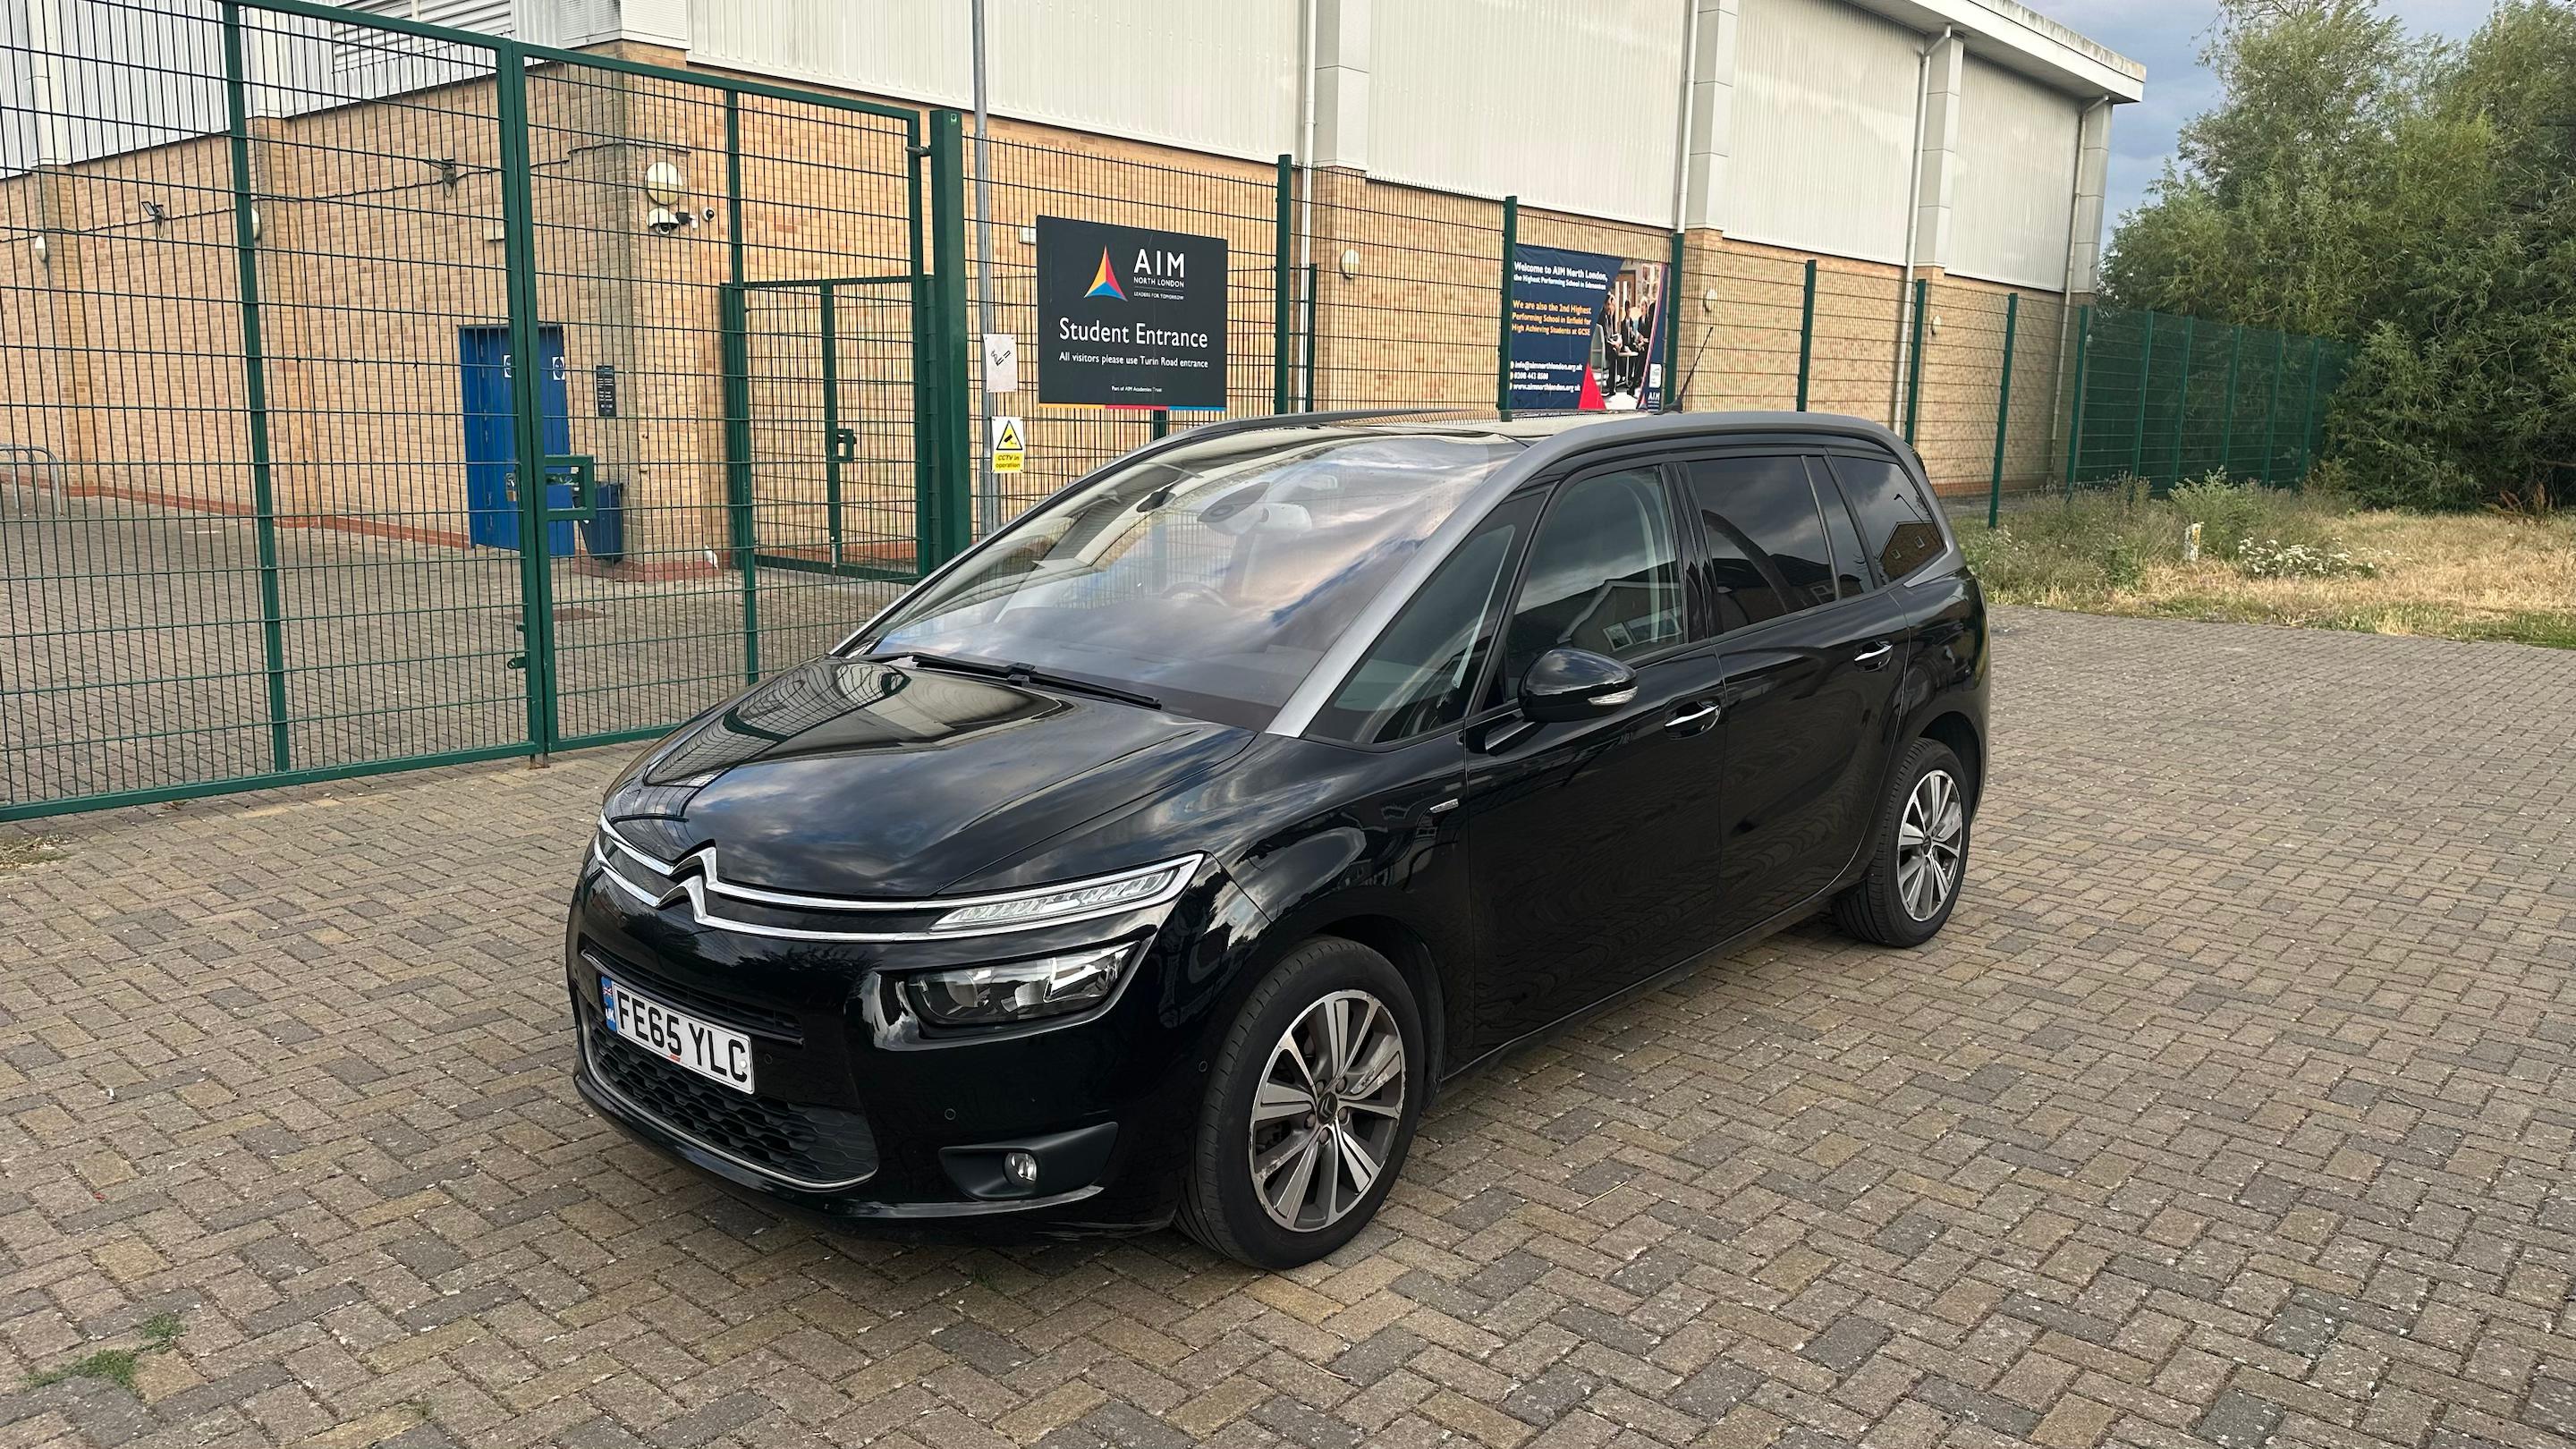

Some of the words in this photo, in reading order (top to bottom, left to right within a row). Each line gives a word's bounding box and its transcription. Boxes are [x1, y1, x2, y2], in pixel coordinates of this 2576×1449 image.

[1134, 249, 1184, 278] AIM
[1513, 261, 1544, 274] Welcome
[1545, 266, 1552, 275] to
[1553, 266, 1565, 275] AIM
[1566, 267, 1584, 278] North
[1134, 276, 1156, 285] NORTH
[1157, 278, 1184, 288] LONDON
[1513, 274, 1522, 282] the
[1522, 275, 1540, 284] Highest
[1540, 276, 1565, 287] Performing
[1565, 279, 1580, 287] School
[1513, 300, 1524, 309] We
[1524, 301, 1535, 310] are
[1536, 301, 1547, 311] also
[1548, 302, 1558, 311] the
[1559, 304, 1570, 313] 2nd
[1571, 304, 1591, 316] Highest
[1512, 312, 1542, 324] Performing
[1543, 314, 1560, 323] School
[1566, 317, 1584, 325] Enfield
[1059, 317, 1130, 343] Student
[1136, 322, 1208, 348] Entrance
[1512, 323, 1524, 334] High
[1525, 324, 1549, 335] Achieving
[1550, 326, 1571, 335] Students
[1578, 327, 1590, 336] GCSE
[1059, 351, 1070, 360] All
[1072, 352, 1099, 362] visitors
[1101, 353, 1124, 365] please
[1125, 357, 1138, 365] use
[1140, 355, 1159, 366] Turin
[1160, 356, 1178, 367] Road
[1180, 360, 1208, 368] entrance
[1648, 392, 1660, 401] AIM
[605, 1007, 616, 1022] UK
[616, 989, 682, 1056] FE65
[688, 1022, 748, 1083] YLC
